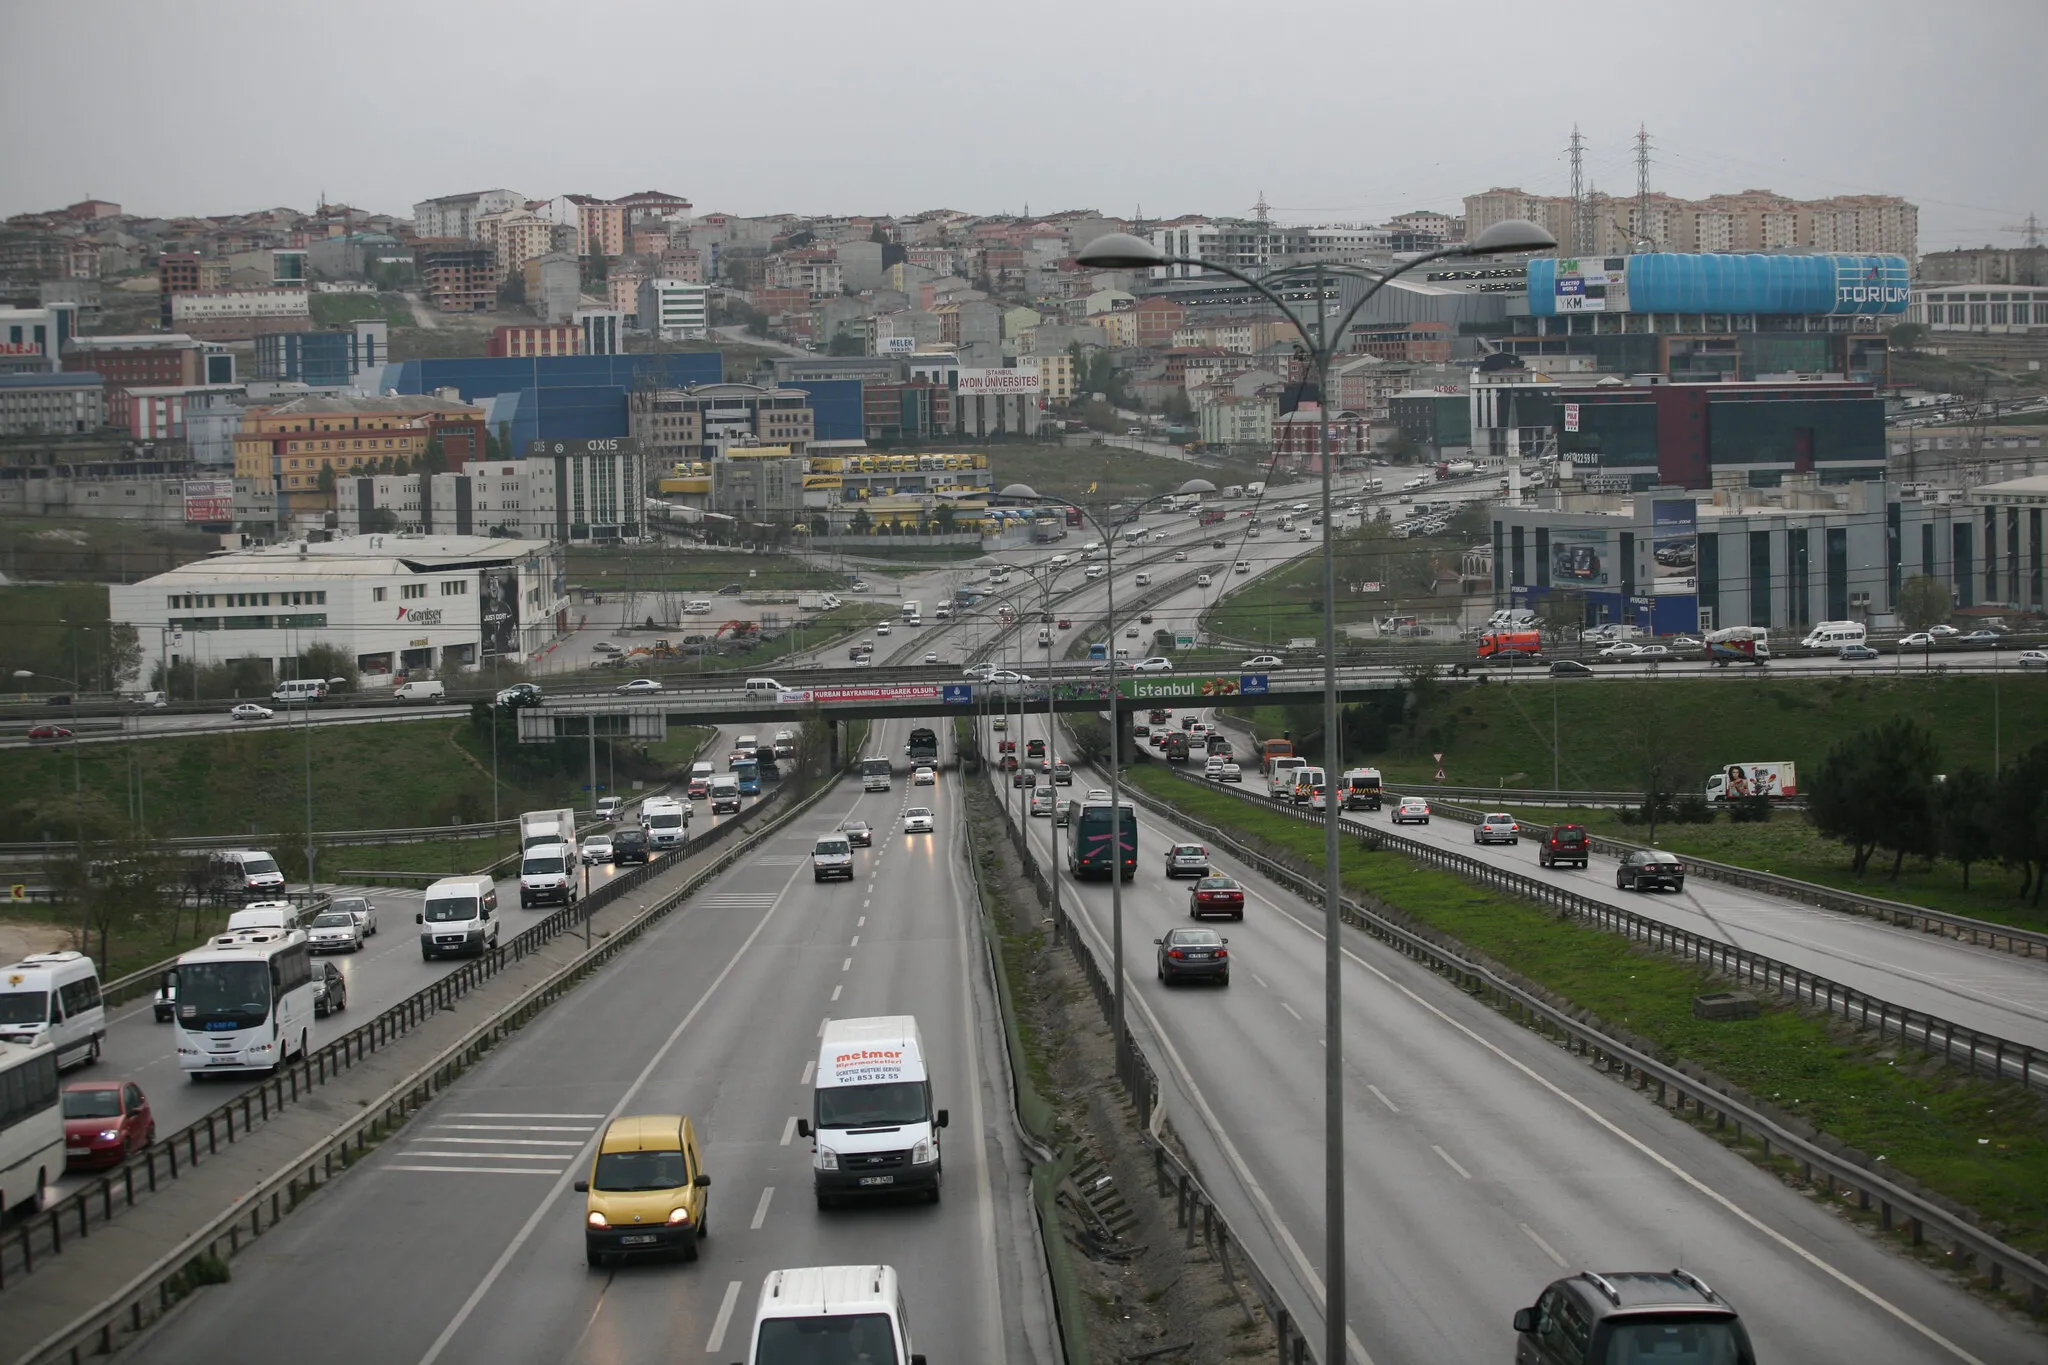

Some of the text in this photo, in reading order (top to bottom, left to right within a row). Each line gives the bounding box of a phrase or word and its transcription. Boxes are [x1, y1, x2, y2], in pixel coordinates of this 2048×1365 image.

[1839, 286, 1910, 303] TORIUM
[1560, 297, 1582, 309] YKM
[889, 339, 913, 347] MELEK
[985, 368, 1013, 376] İSTANBUL
[959, 374, 1039, 389] AYDIN ÜNİVERSİTESİ
[814, 690, 841, 699] KURBAN
[842, 689, 880, 697] BAYRAMINIZ
[1133, 680, 1195, 698] İstanbul
[836, 1050, 903, 1063] metmar
